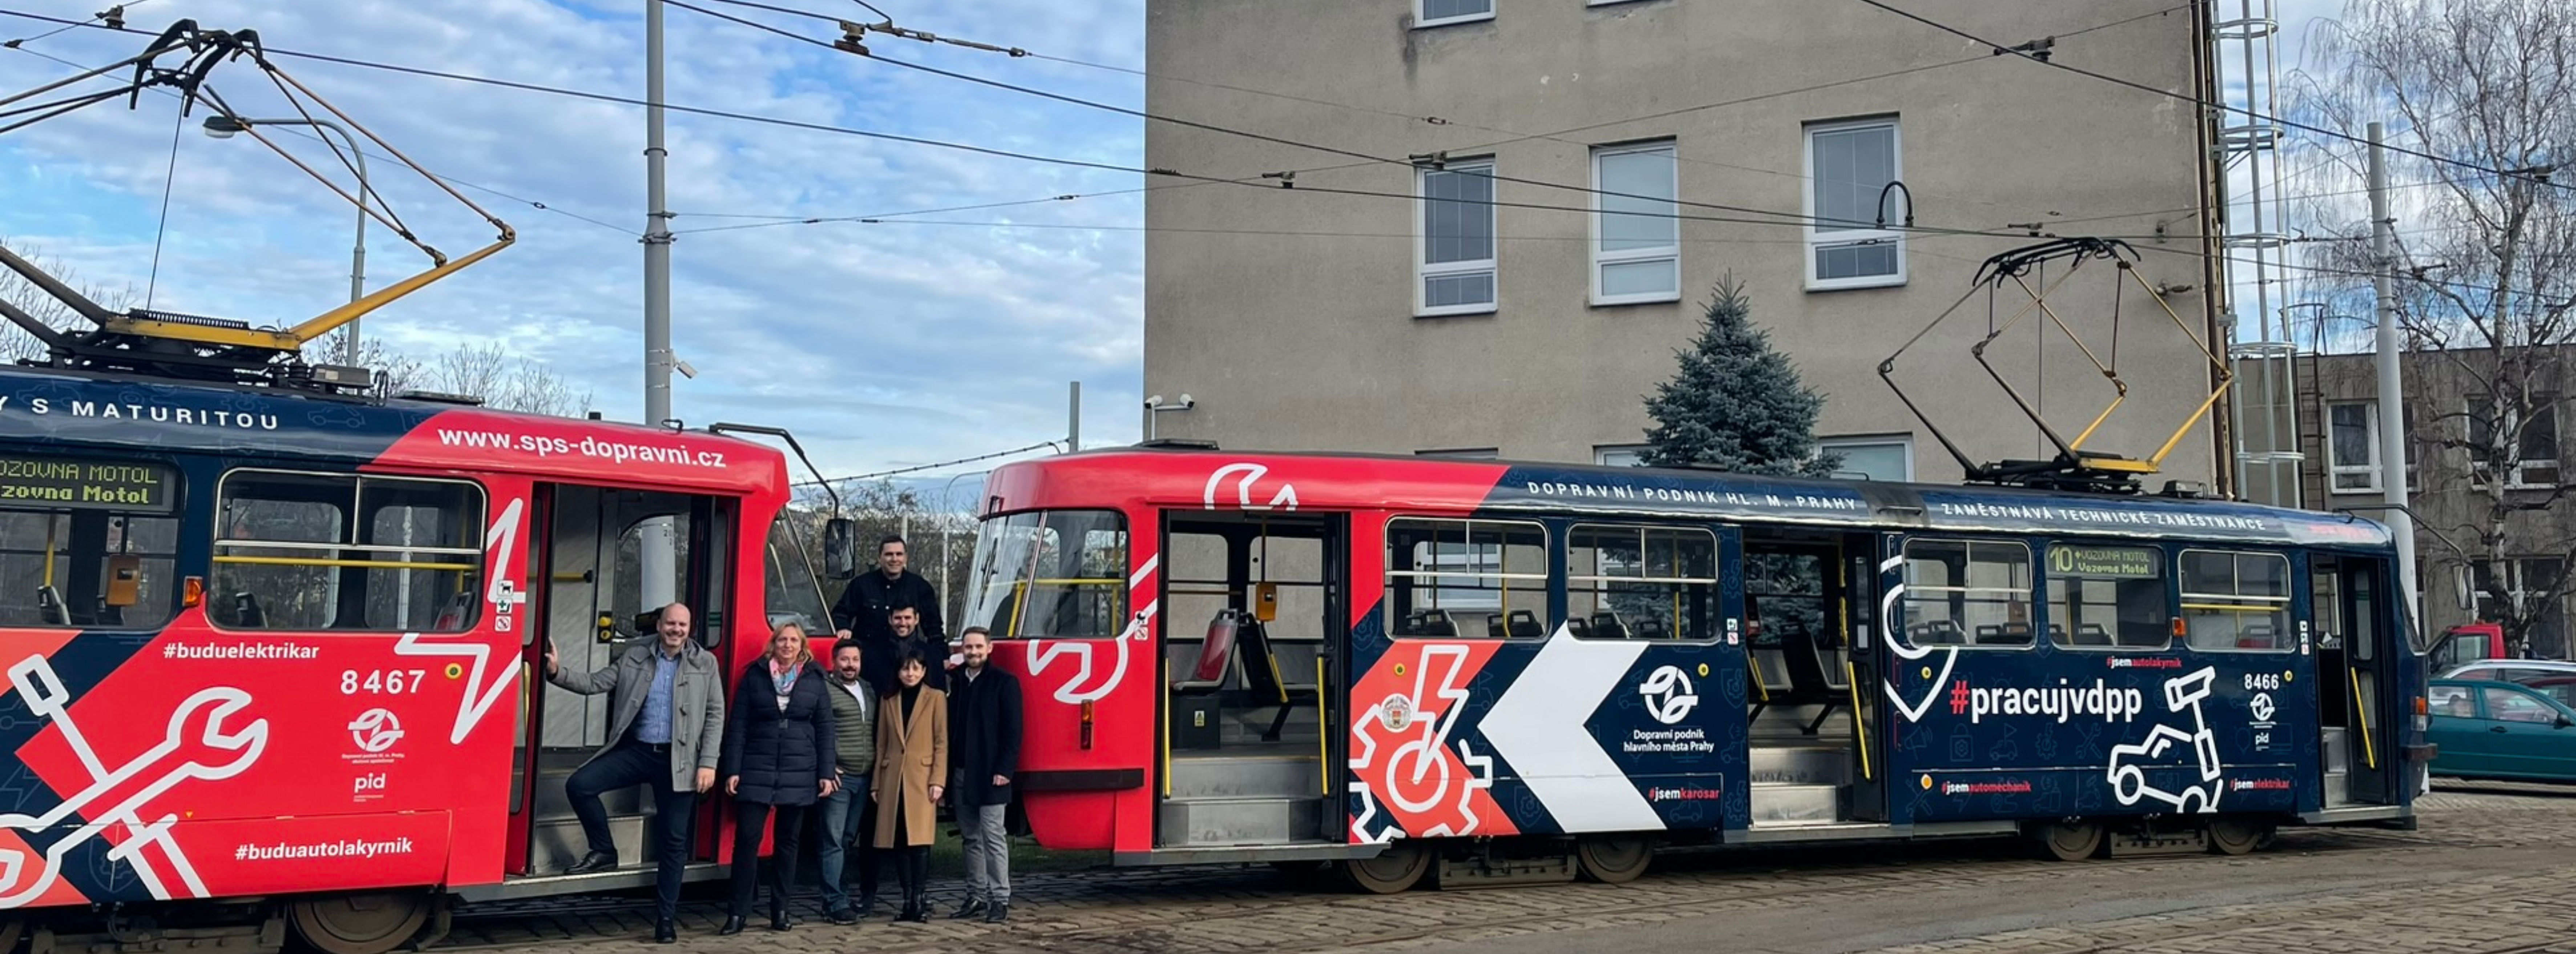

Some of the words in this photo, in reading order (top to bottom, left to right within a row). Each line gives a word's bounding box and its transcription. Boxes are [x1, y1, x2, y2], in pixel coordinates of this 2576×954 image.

[32, 398, 49, 414] S
[72, 400, 278, 430] MATURITOU
[437, 428, 726, 468] www.sps-dopravni.cz
[88, 464, 157, 484] MOTOL
[82, 485, 149, 504] Motol
[1527, 482, 1634, 499] DOPRAVNÍ
[1643, 488, 1719, 504] PODNIK
[1726, 492, 1758, 506] HL.
[1766, 495, 1789, 507] M.
[1795, 496, 1854, 510] PRAHY
[2058, 509, 2150, 524] TECHNICKÉ
[2155, 513, 2266, 531] ZAMĚSTNANCE
[2050, 547, 2073, 572] 10
[2078, 562, 2119, 573] Vozovna
[2122, 563, 2149, 574] Motol
[163, 642, 319, 659] #buduelektrikar
[340, 669, 426, 695] 8467
[2245, 673, 2279, 690] 8466
[1950, 678, 2142, 724] #pracujvdpp
[1634, 729, 1673, 741] Dopravní
[1674, 728, 1705, 741] podnik
[2256, 732, 2269, 745] pid
[1623, 741, 1661, 752] hlavního
[1663, 741, 1688, 752] města
[1690, 741, 1715, 753] Prahy
[354, 773, 386, 793] pid
[1648, 786, 1719, 802] #jsemkarosar
[235, 838, 412, 860] #buduautolakyrnik
